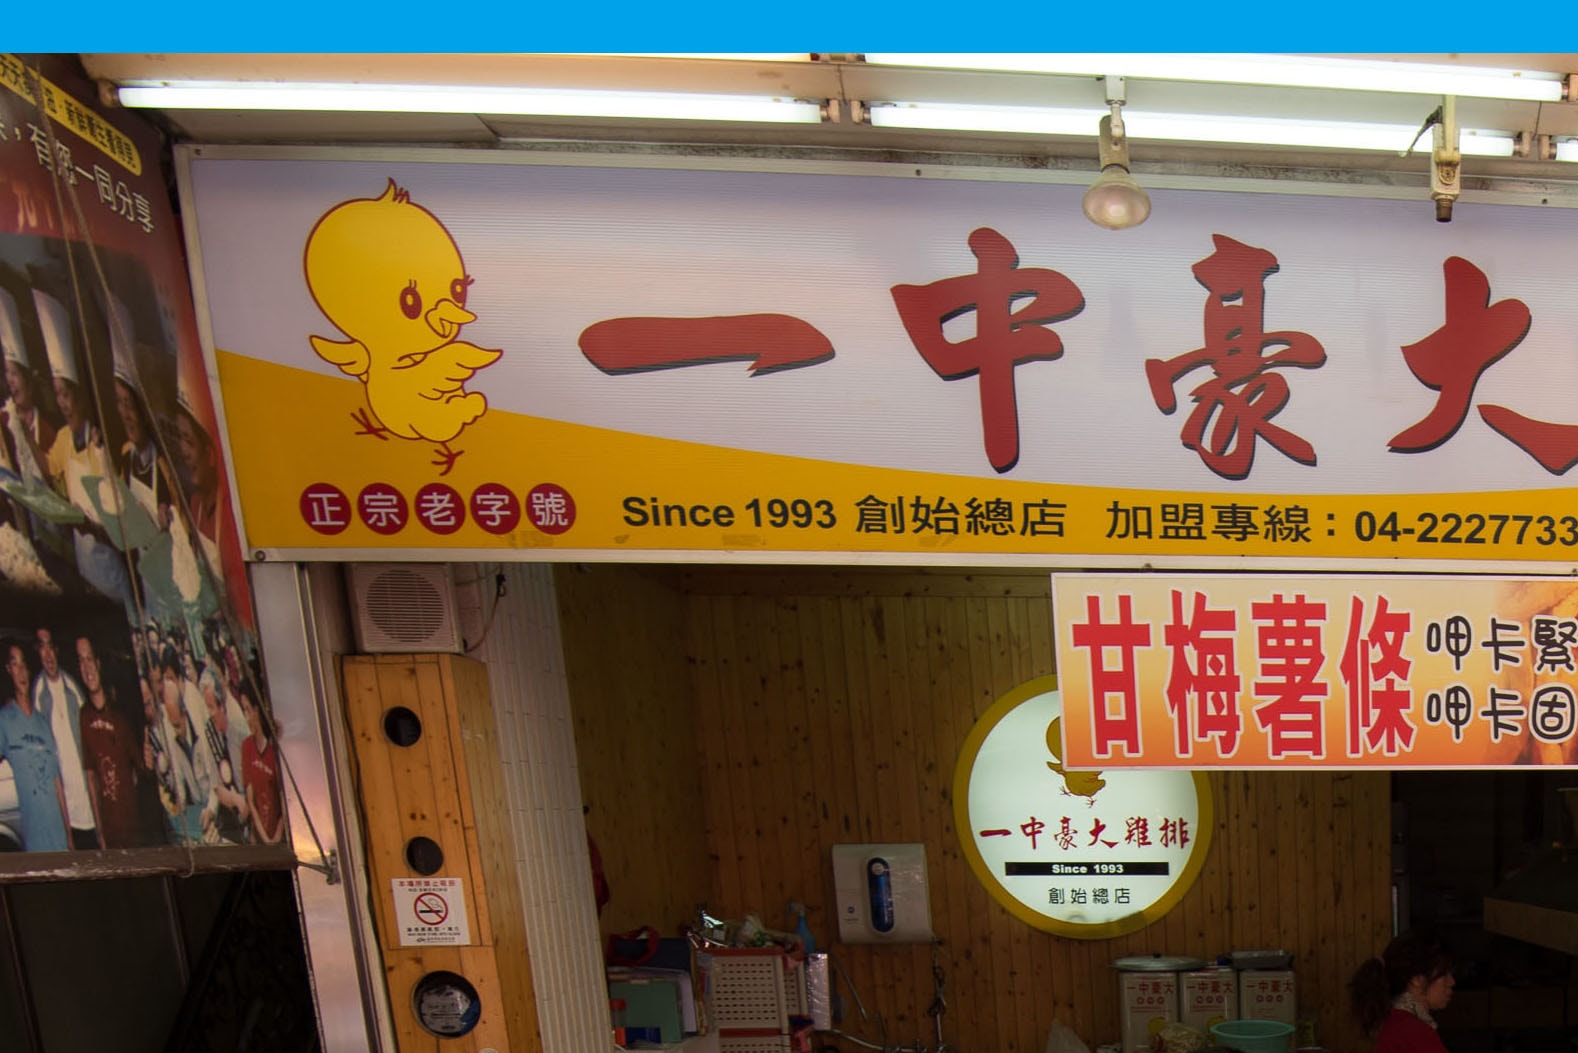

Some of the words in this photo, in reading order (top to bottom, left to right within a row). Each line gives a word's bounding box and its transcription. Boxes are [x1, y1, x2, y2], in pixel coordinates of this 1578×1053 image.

[306, 487, 571, 530] 正宗老字號
[622, 495, 735, 529] Since
[745, 499, 837, 530] 1993
[854, 494, 1068, 537] 創始總店
[1071, 589, 1418, 760] 甘梅薯條
[978, 815, 1190, 852] 一中豪大雞排
[1051, 863, 1088, 874] Since
[1093, 863, 1125, 874] 1993
[1047, 886, 1132, 906] 創始總店
